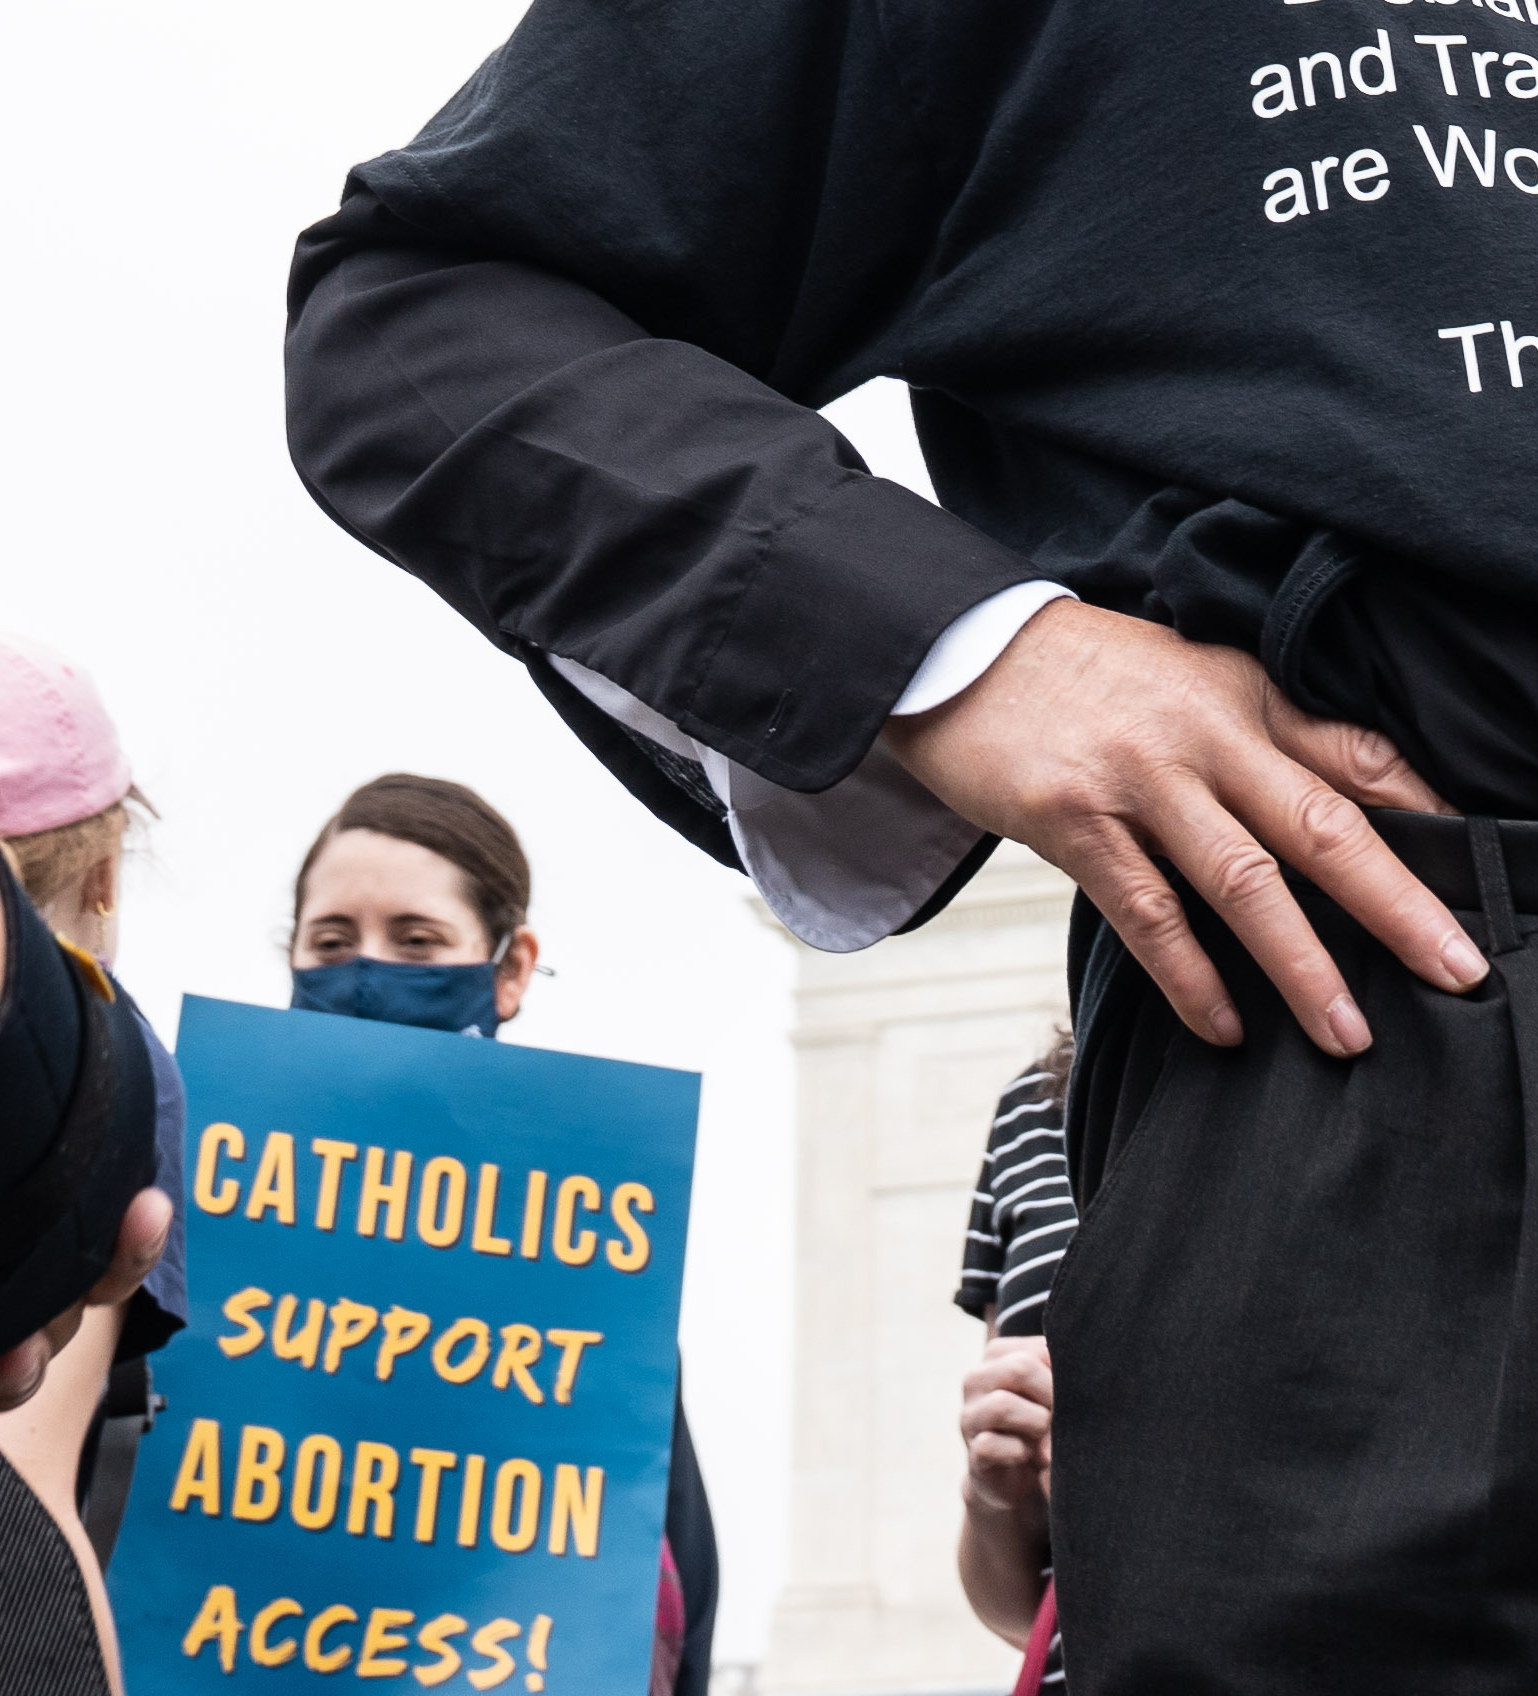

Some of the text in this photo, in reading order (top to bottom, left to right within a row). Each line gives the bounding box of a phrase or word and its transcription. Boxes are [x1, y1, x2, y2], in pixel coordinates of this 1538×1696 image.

[1249, 28, 1398, 119] and
[1262, 148, 1391, 223] are
[193, 1122, 655, 1273] CATHOLICS
[218, 1287, 603, 1405] SUPPORT
[170, 1418, 605, 1558] ABORTION
[182, 1585, 553, 1692] ACCESS!
